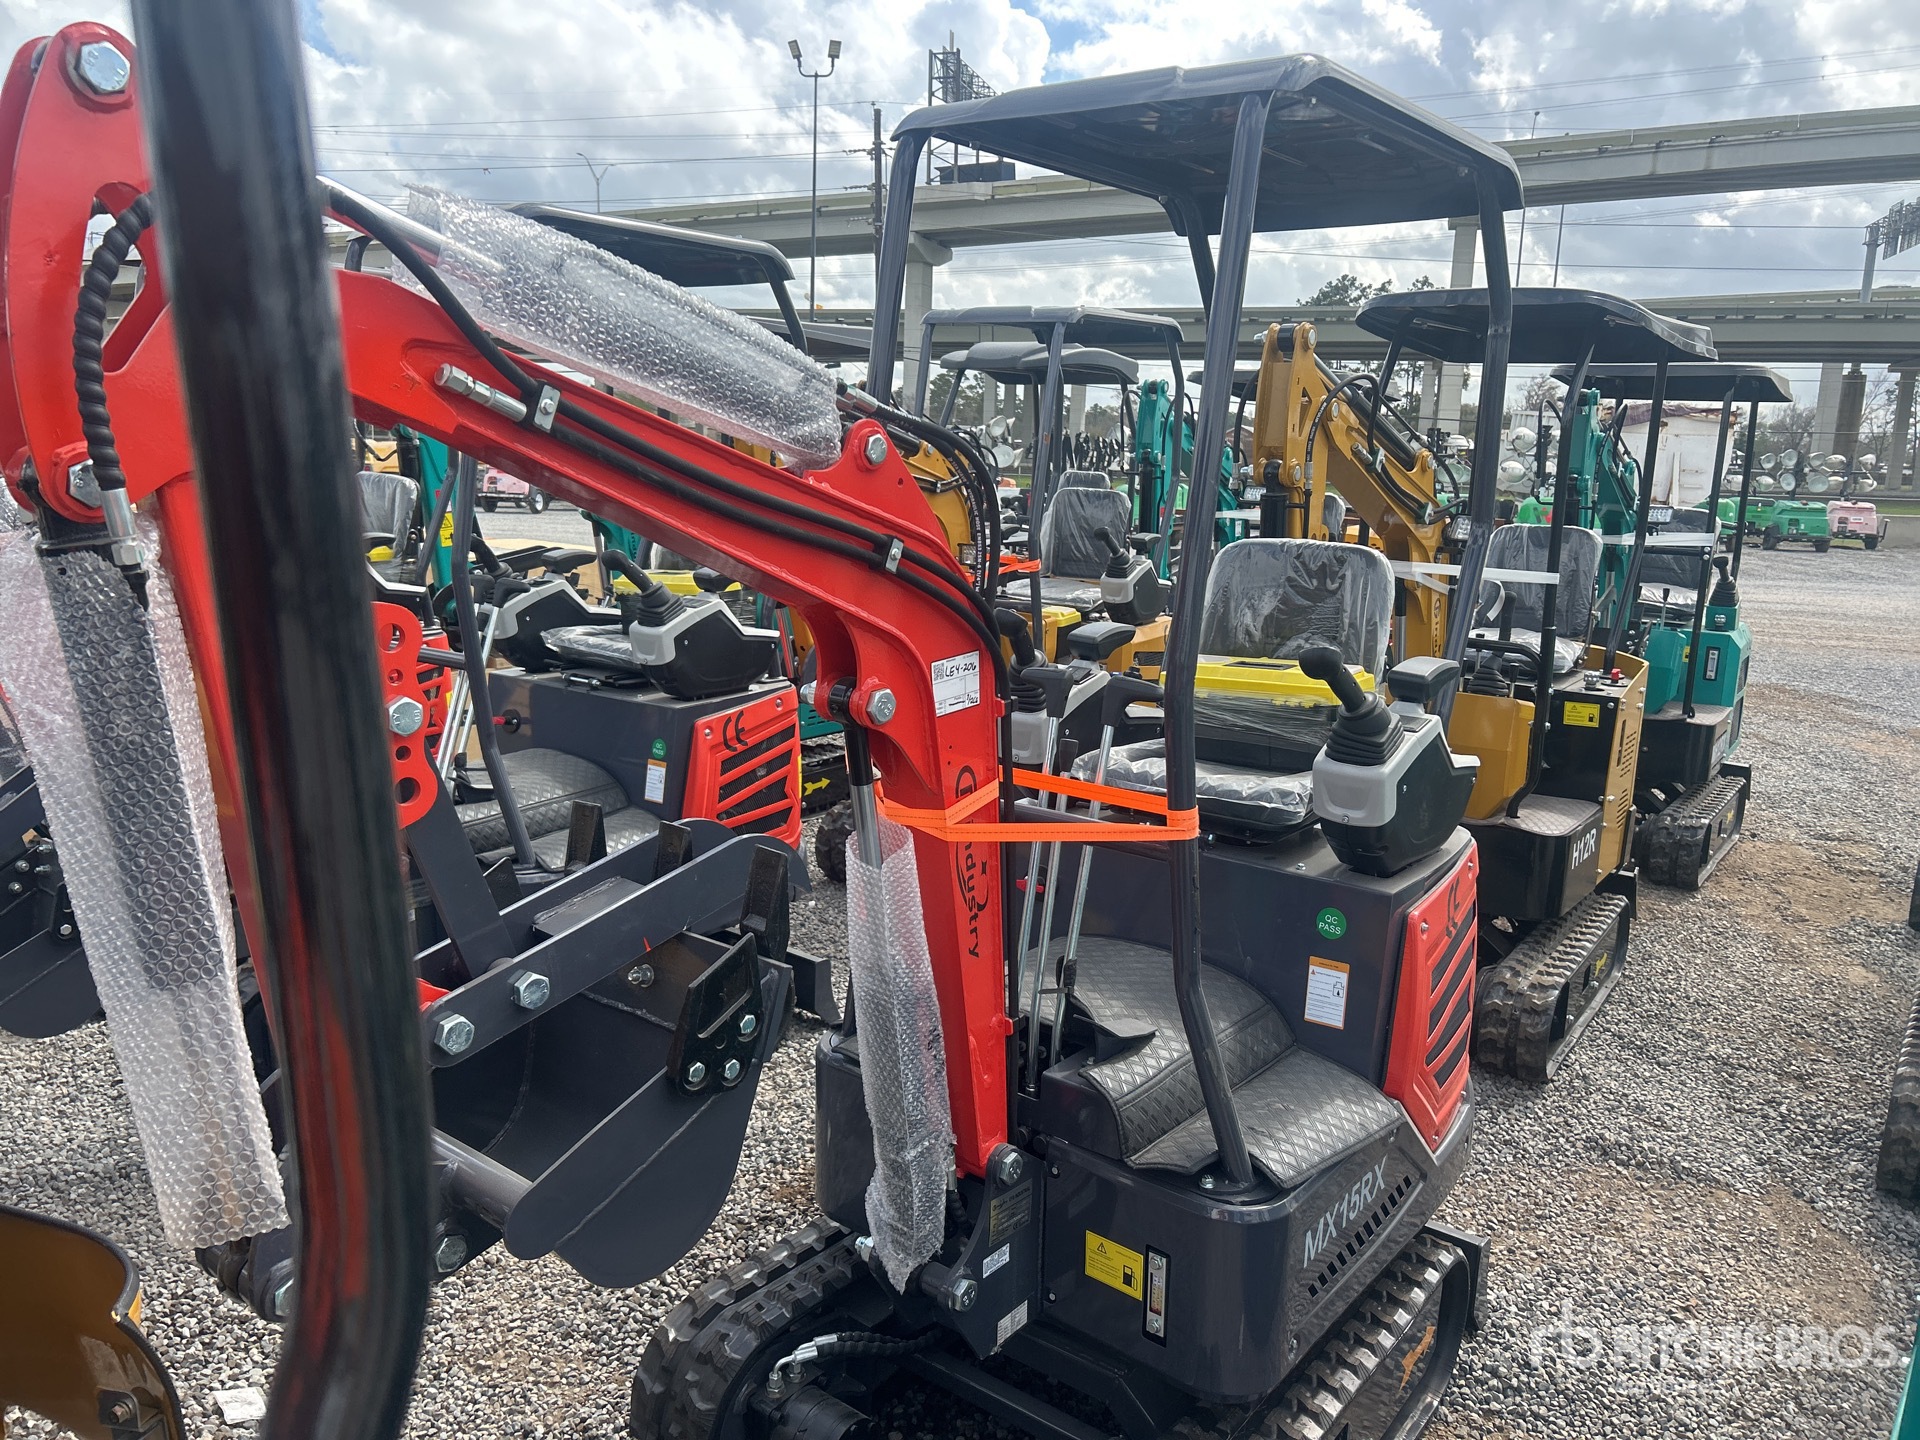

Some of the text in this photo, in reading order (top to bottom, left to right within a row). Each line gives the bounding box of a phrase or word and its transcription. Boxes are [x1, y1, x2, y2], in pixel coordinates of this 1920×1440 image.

[967, 489, 978, 515] HYDRAULIC
[1571, 827, 1597, 870] H12R
[963, 820, 980, 958] ndustry
[1317, 921, 1342, 935] PASS
[1324, 914, 1338, 925] QC
